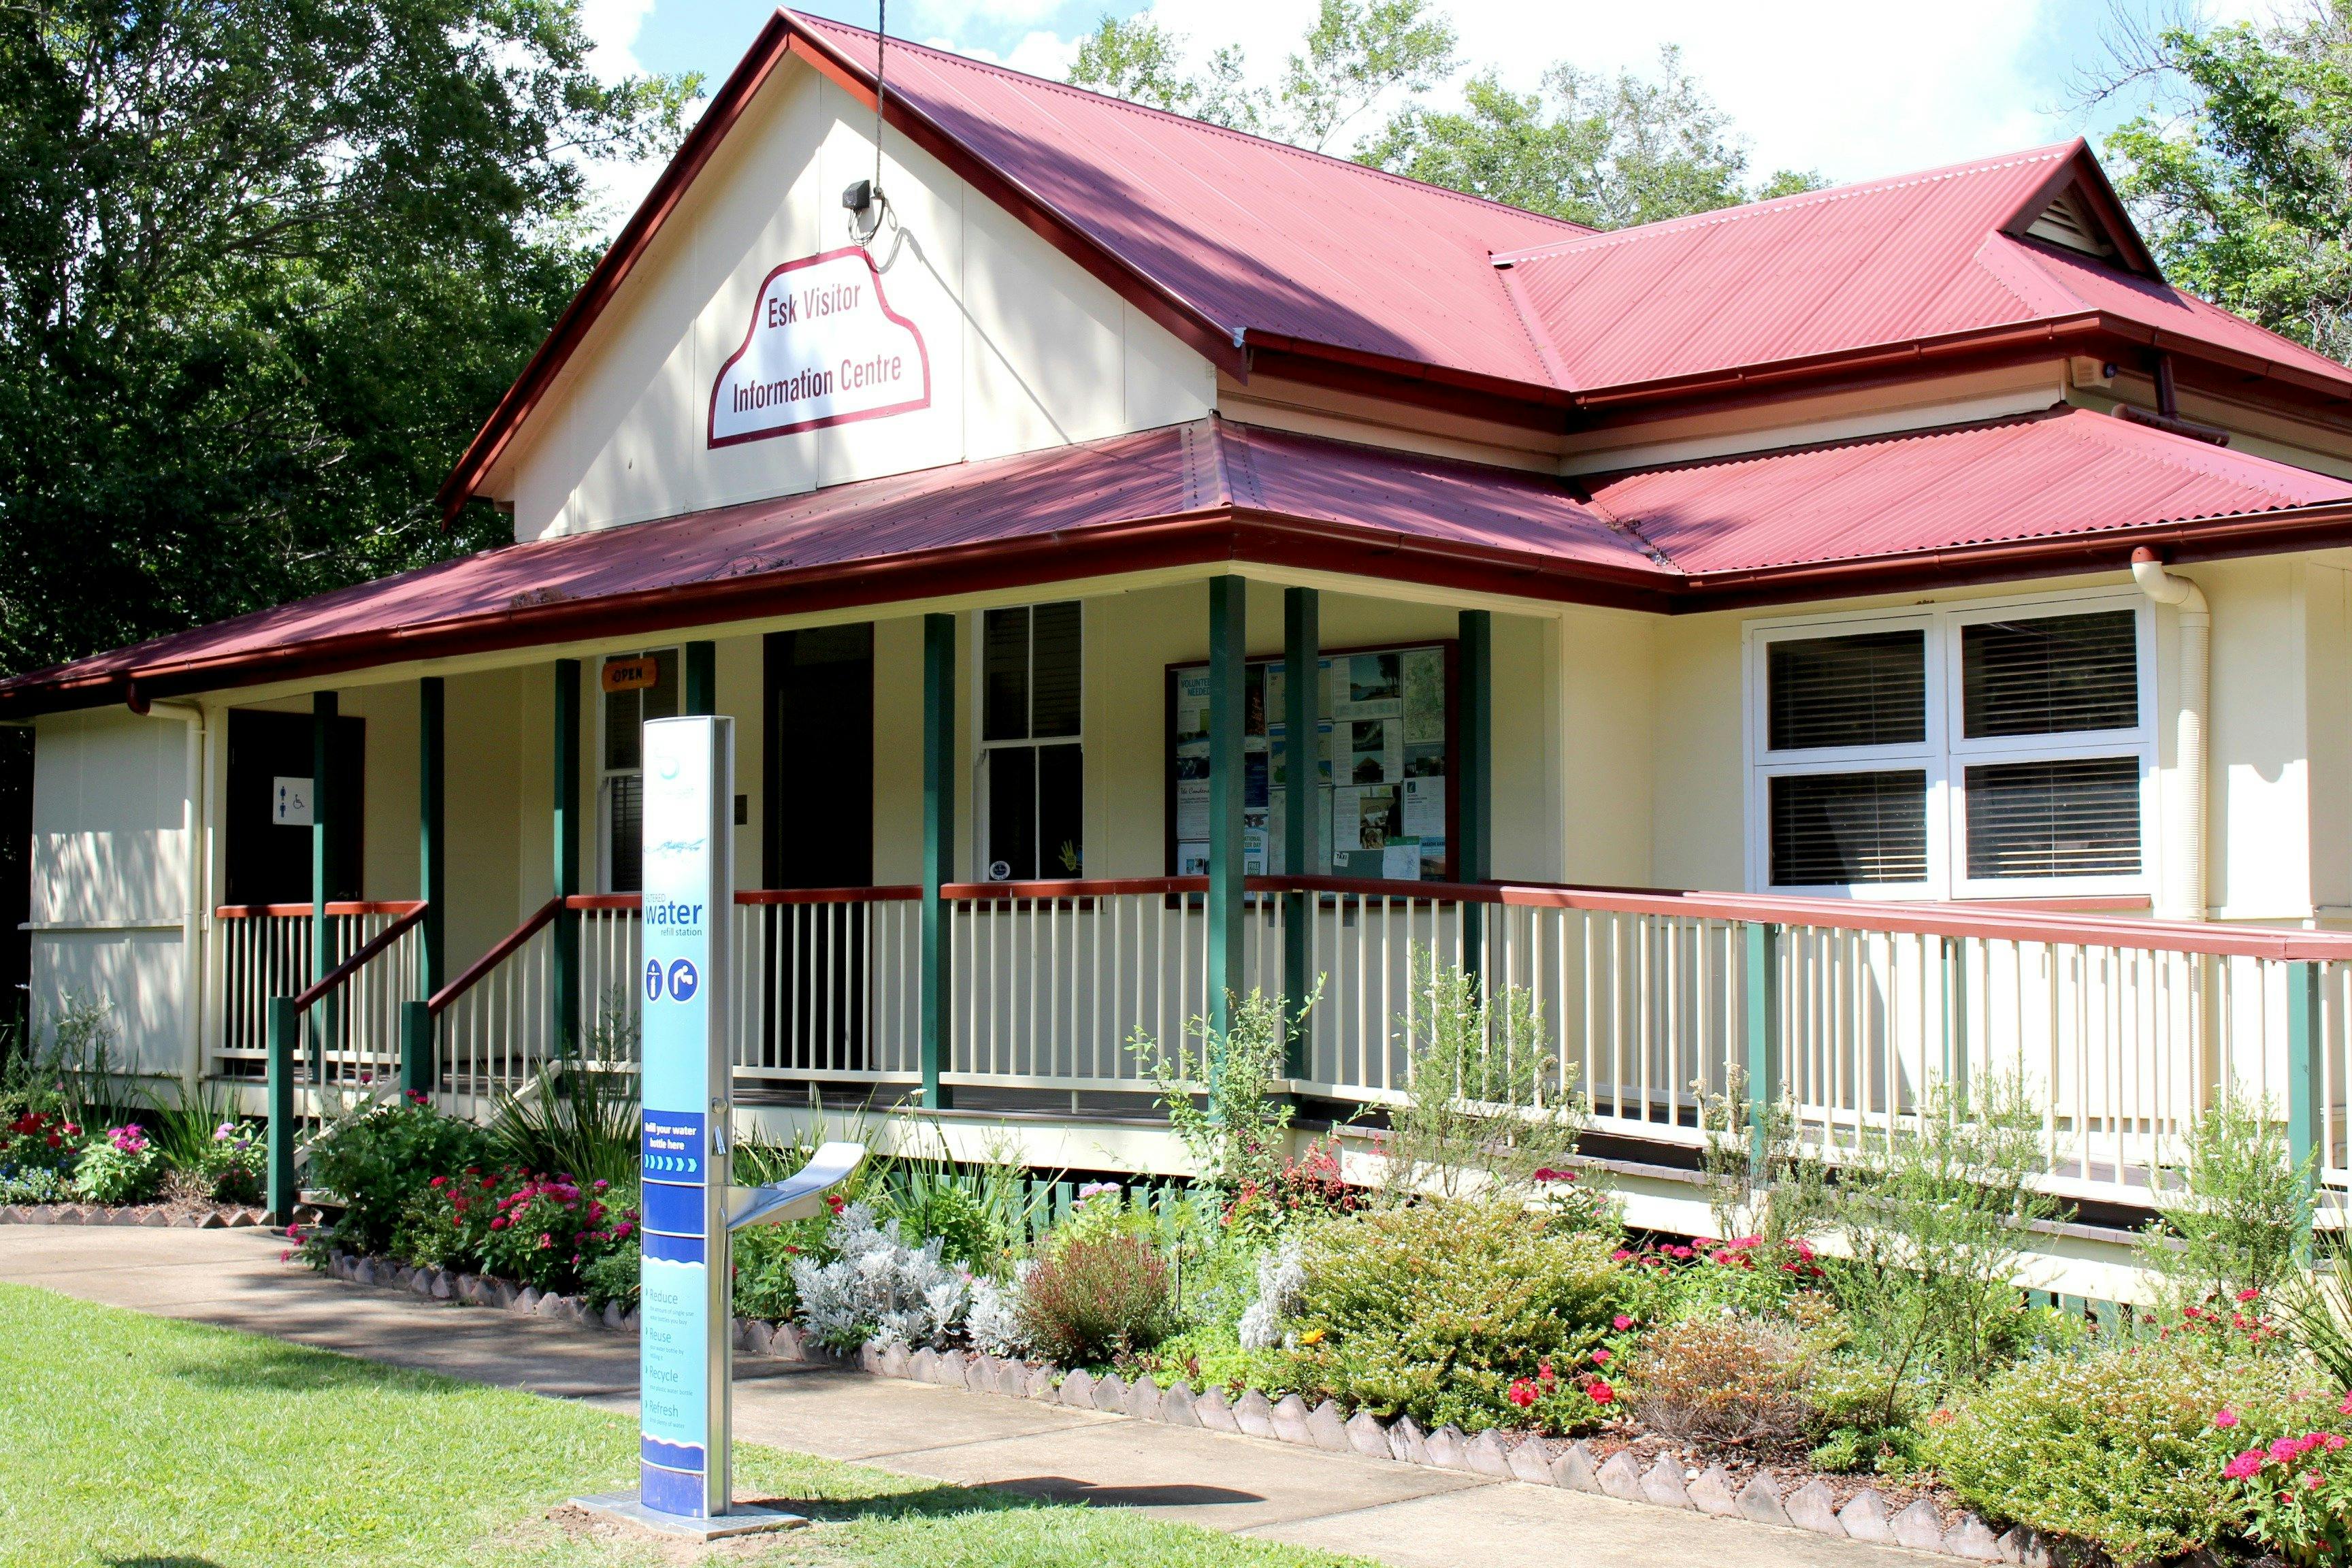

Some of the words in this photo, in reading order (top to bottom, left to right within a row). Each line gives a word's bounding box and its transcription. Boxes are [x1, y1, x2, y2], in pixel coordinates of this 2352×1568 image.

[768, 293, 798, 329] Esk
[804, 283, 861, 319] Visitor
[733, 368, 833, 413] Information
[840, 355, 902, 391] Centre
[612, 667, 642, 683] OPEN
[1181, 678, 1210, 687] VOLUNTE
[645, 900, 703, 925] water
[661, 927, 674, 936] refill
[675, 927, 702, 936] station
[656, 1125, 672, 1136] your
[672, 1126, 697, 1136] water
[668, 1139, 685, 1150] here
[650, 1288, 678, 1305] Reduce
[650, 1327, 672, 1343] Reuse
[649, 1365, 679, 1383] Recycle
[679, 1388, 693, 1396] bottle
[649, 1400, 679, 1418] Refresh
